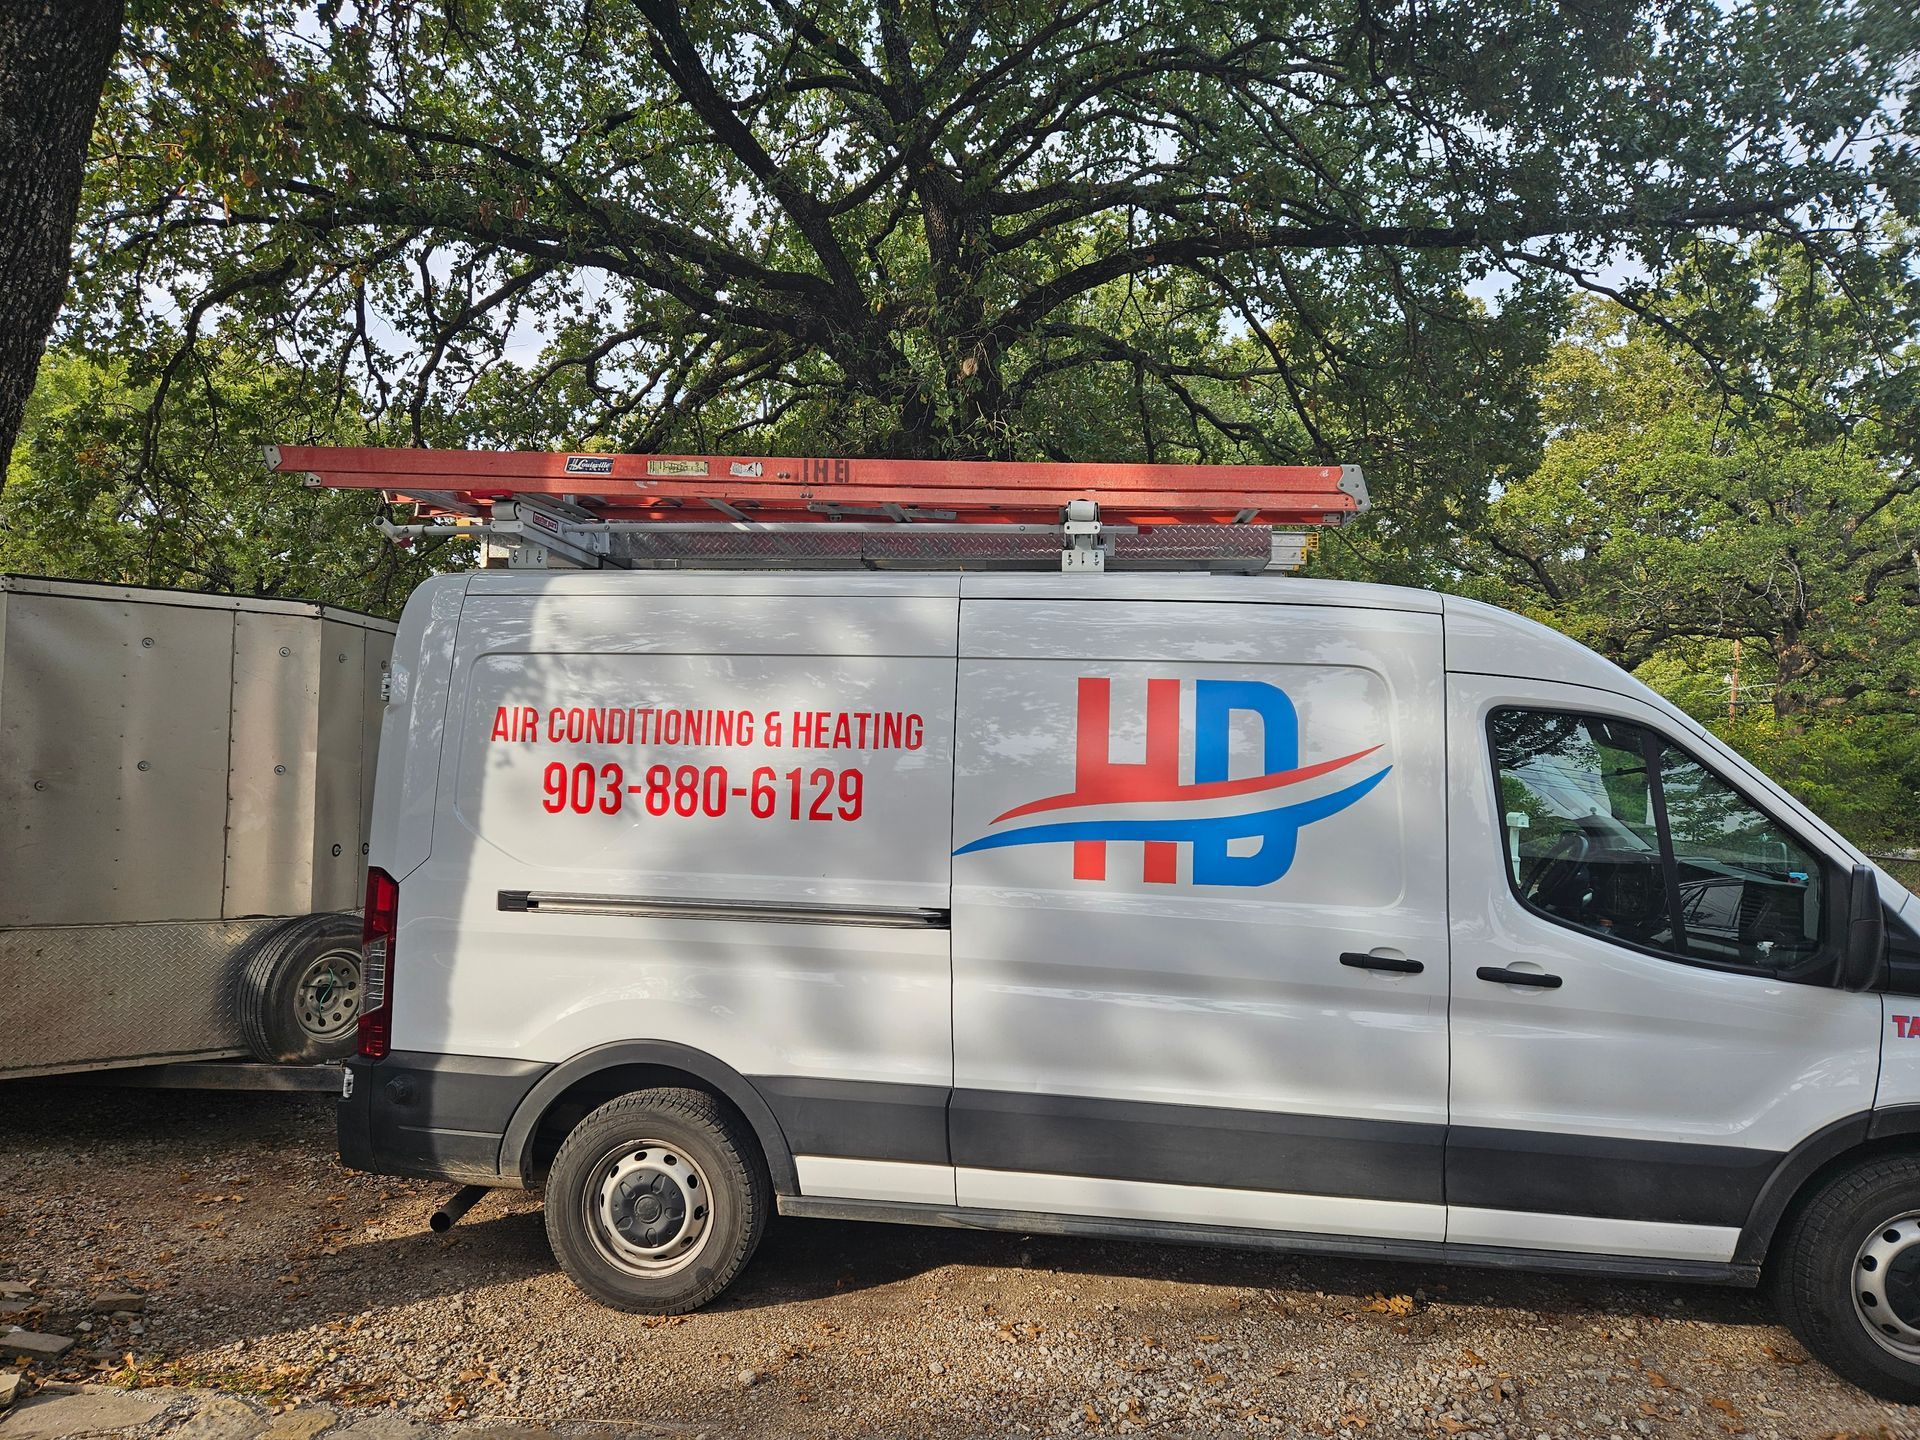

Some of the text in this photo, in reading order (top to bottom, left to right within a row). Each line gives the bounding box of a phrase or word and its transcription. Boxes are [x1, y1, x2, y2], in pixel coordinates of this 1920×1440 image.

[491, 706, 924, 751] AIR CONDITIONING & HEATING
[542, 761, 864, 822] 903-880-6129
[1073, 677, 1299, 887] HD
